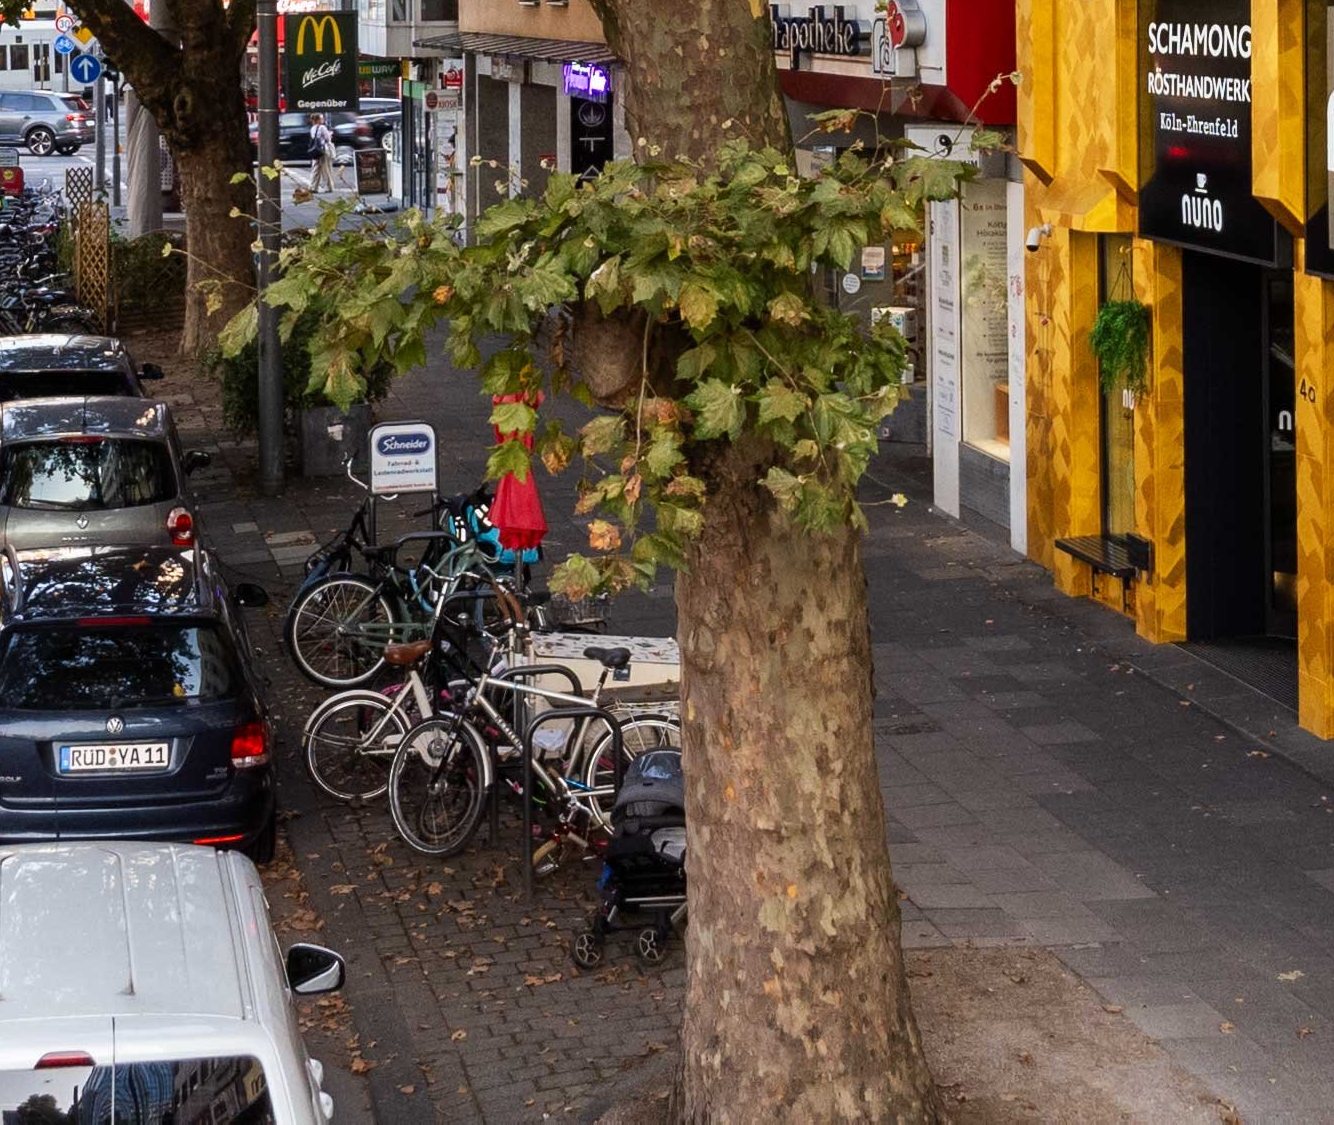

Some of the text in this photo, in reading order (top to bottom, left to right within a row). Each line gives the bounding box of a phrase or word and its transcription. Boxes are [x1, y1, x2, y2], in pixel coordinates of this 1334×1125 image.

[1148, 22, 1251, 59] SCHAMONG
[358, 65, 396, 74] UBWAY
[1148, 66, 1252, 103] RÖSTHANDWERK
[297, 99, 347, 109] Gegenüber
[1160, 112, 1238, 138] Köln-Ehrenfeld
[1181, 193, 1223, 232] nuno
[1299, 378, 1317, 404] 4a
[382, 436, 427, 452] Schneider
[71, 747, 166, 767] RÜD YA 11
